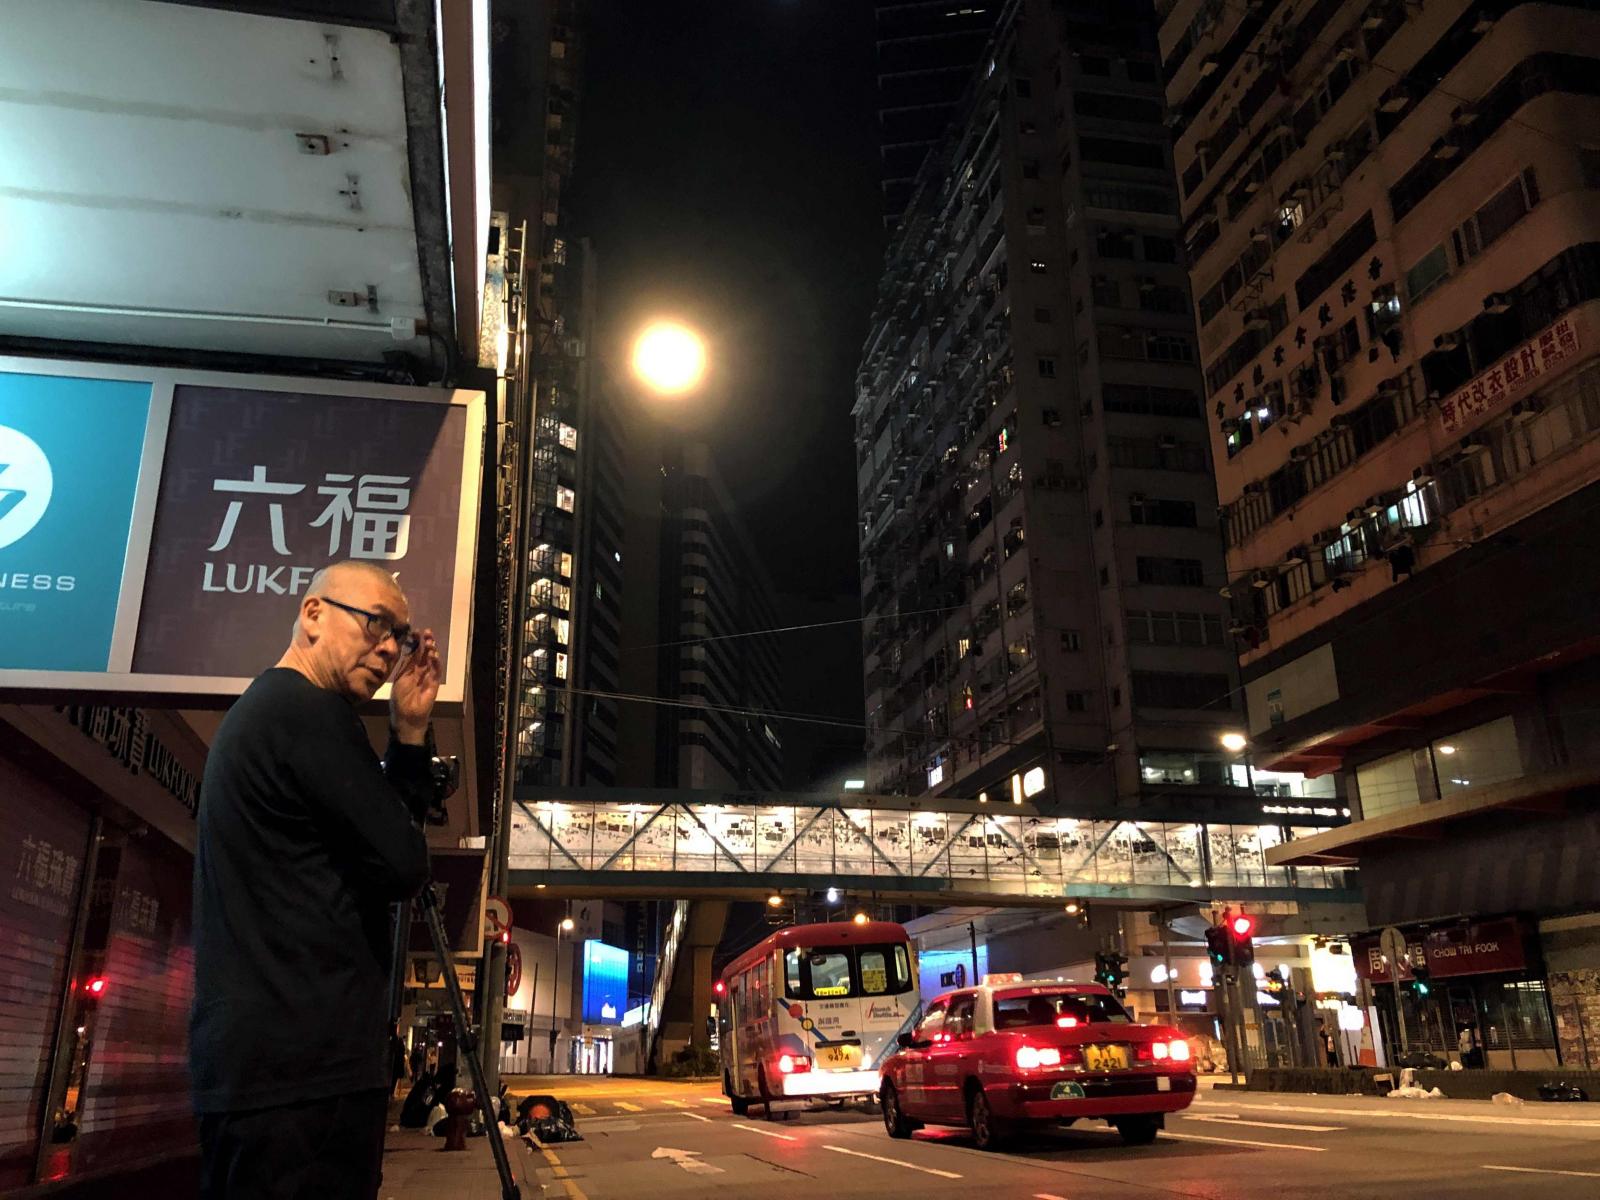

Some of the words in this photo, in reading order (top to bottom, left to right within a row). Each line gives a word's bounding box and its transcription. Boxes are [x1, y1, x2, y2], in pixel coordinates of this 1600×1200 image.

[207, 465, 411, 560] 六福
[202, 562, 400, 595] LUKF
[1433, 948, 1457, 958] CHOW
[1459, 945, 1473, 955] TAI
[1475, 941, 1500, 953] FOOK
[828, 1053, 850, 1061] 9474
[1094, 1057, 1121, 1069] 2421
